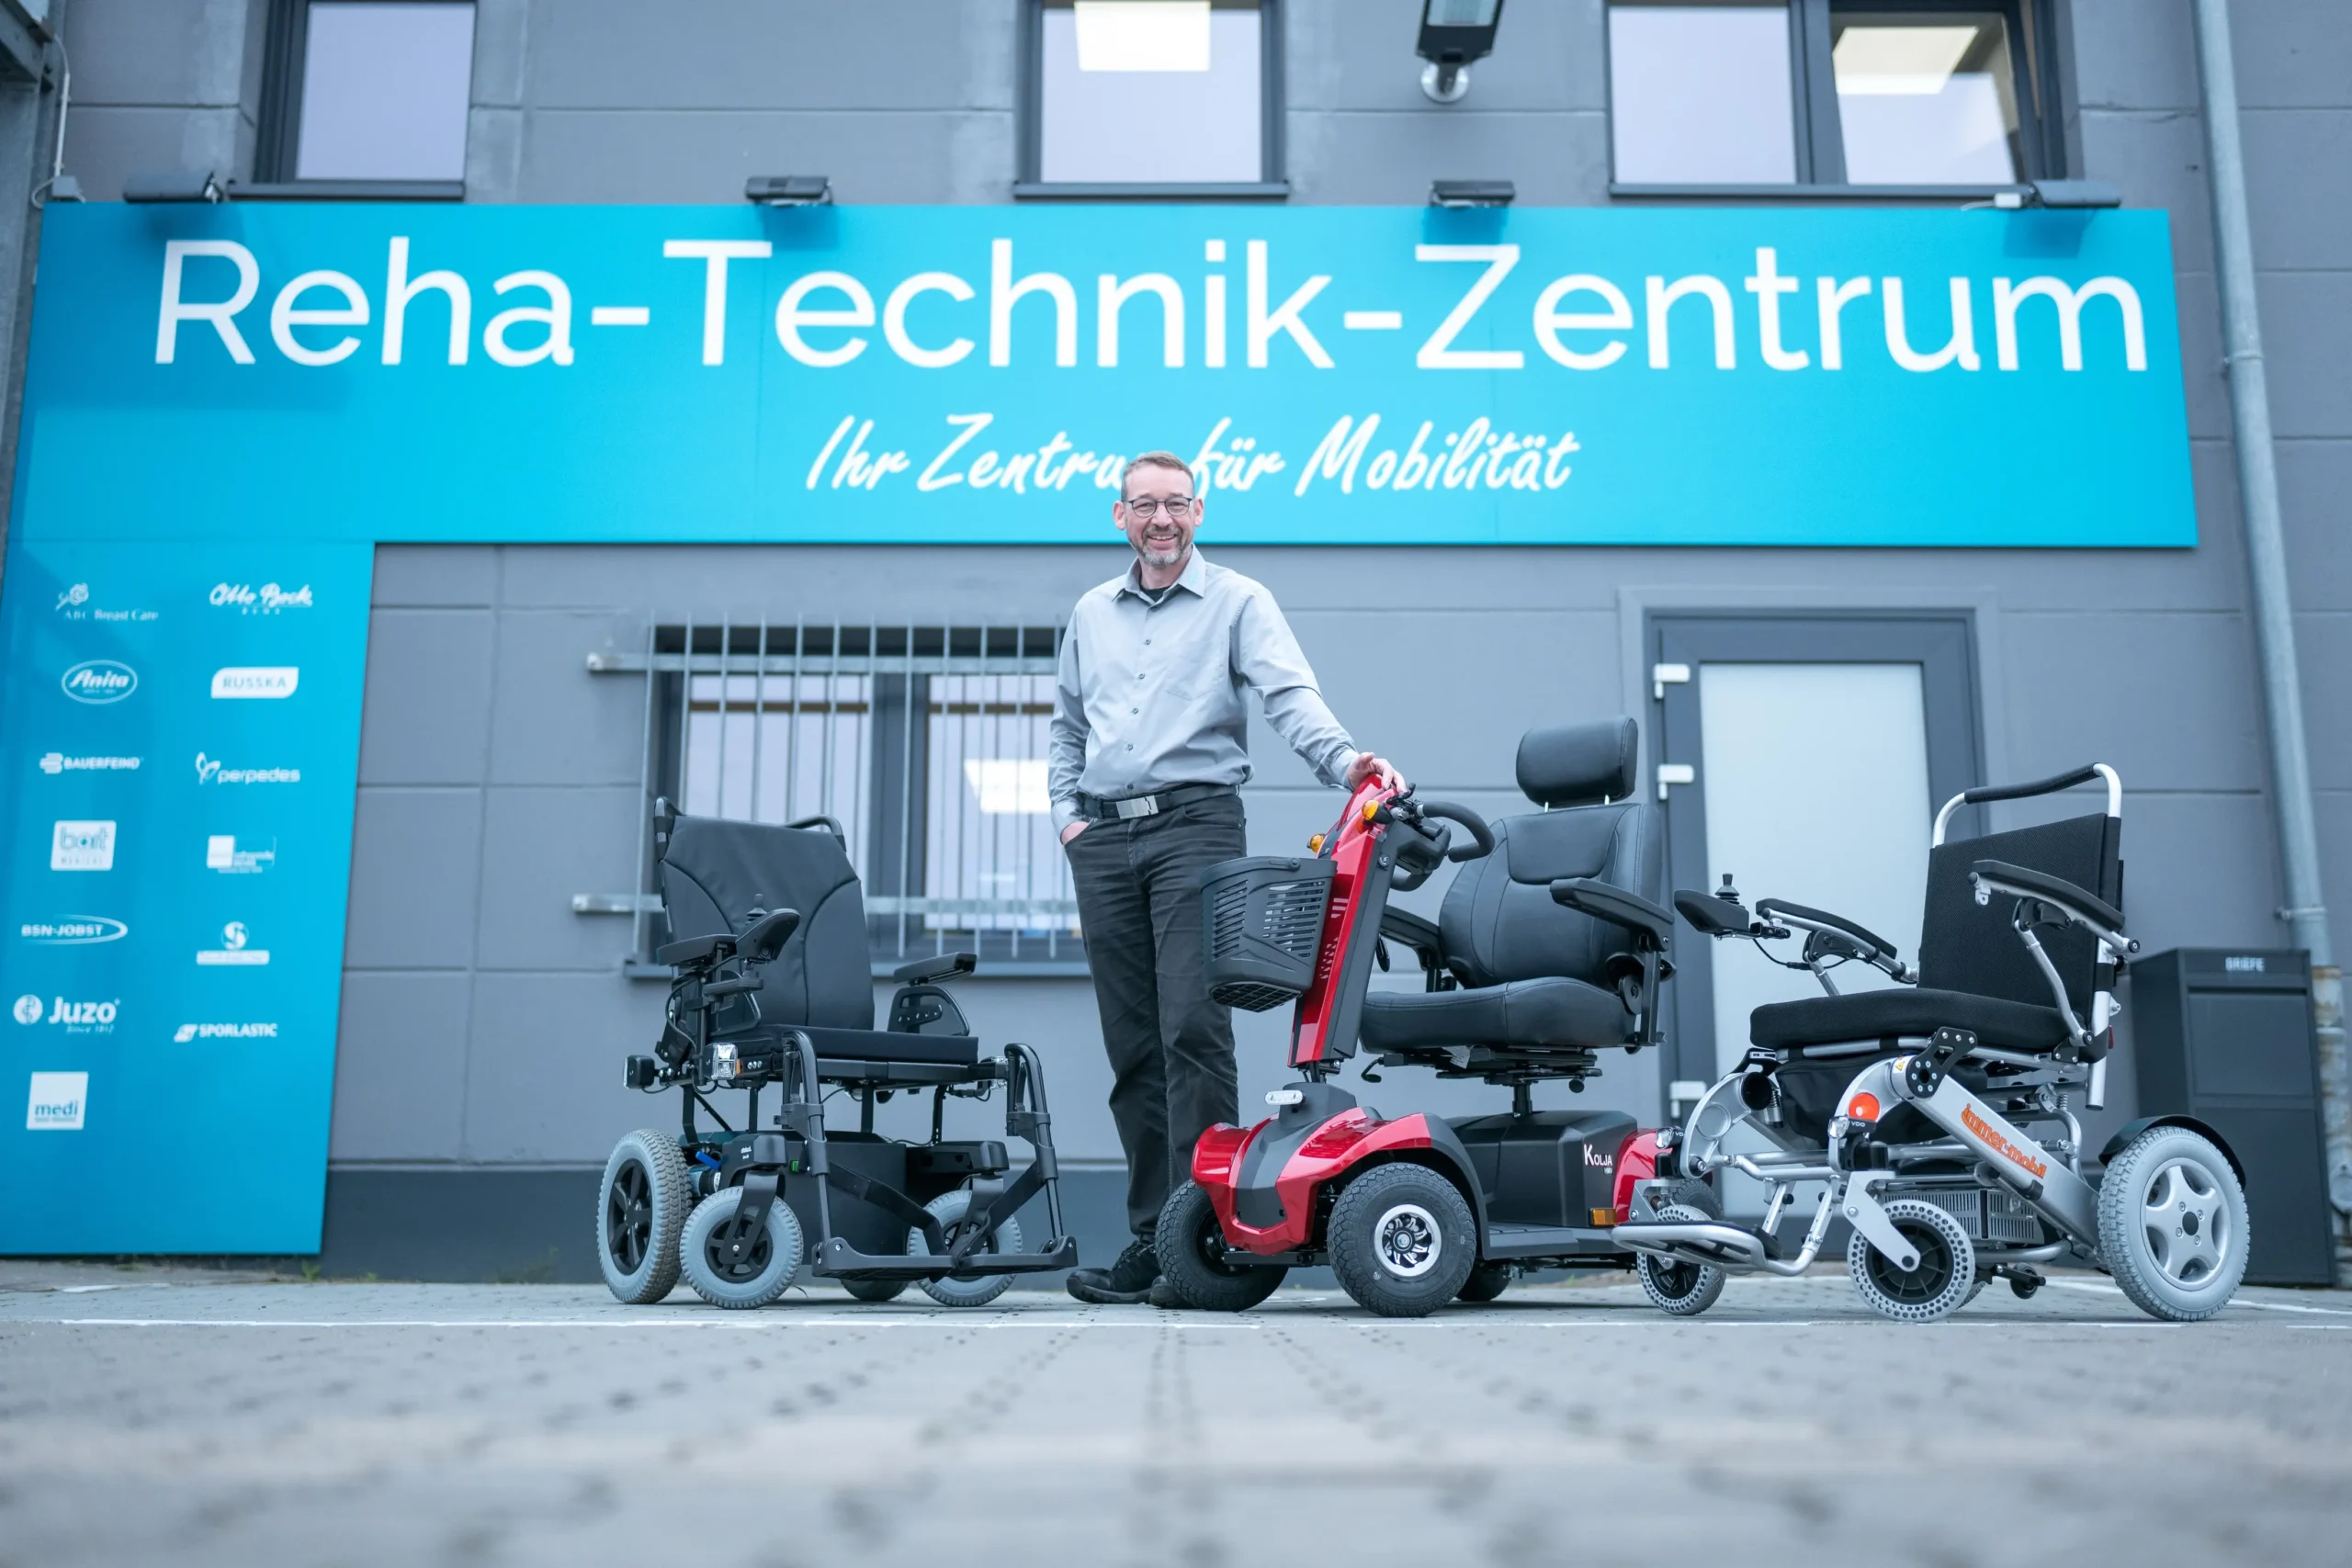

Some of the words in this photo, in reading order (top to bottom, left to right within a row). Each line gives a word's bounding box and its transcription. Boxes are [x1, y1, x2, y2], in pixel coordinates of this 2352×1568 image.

[154, 237, 2148, 372] Reha-Technik-Zentrum
[806, 415, 910, 491] Ihr
[918, 413, 1141, 494] Zentru
[1189, 416, 1286, 501] für
[1295, 413, 1582, 497] Mobilität
[69, 669, 130, 689] Anita
[222, 676, 288, 690] RUSSKA
[217, 766, 300, 785] perpedes
[48, 996, 117, 1024] Juzo
[198, 1023, 278, 1038] SPORLASTIC
[34, 1100, 78, 1116] medi
